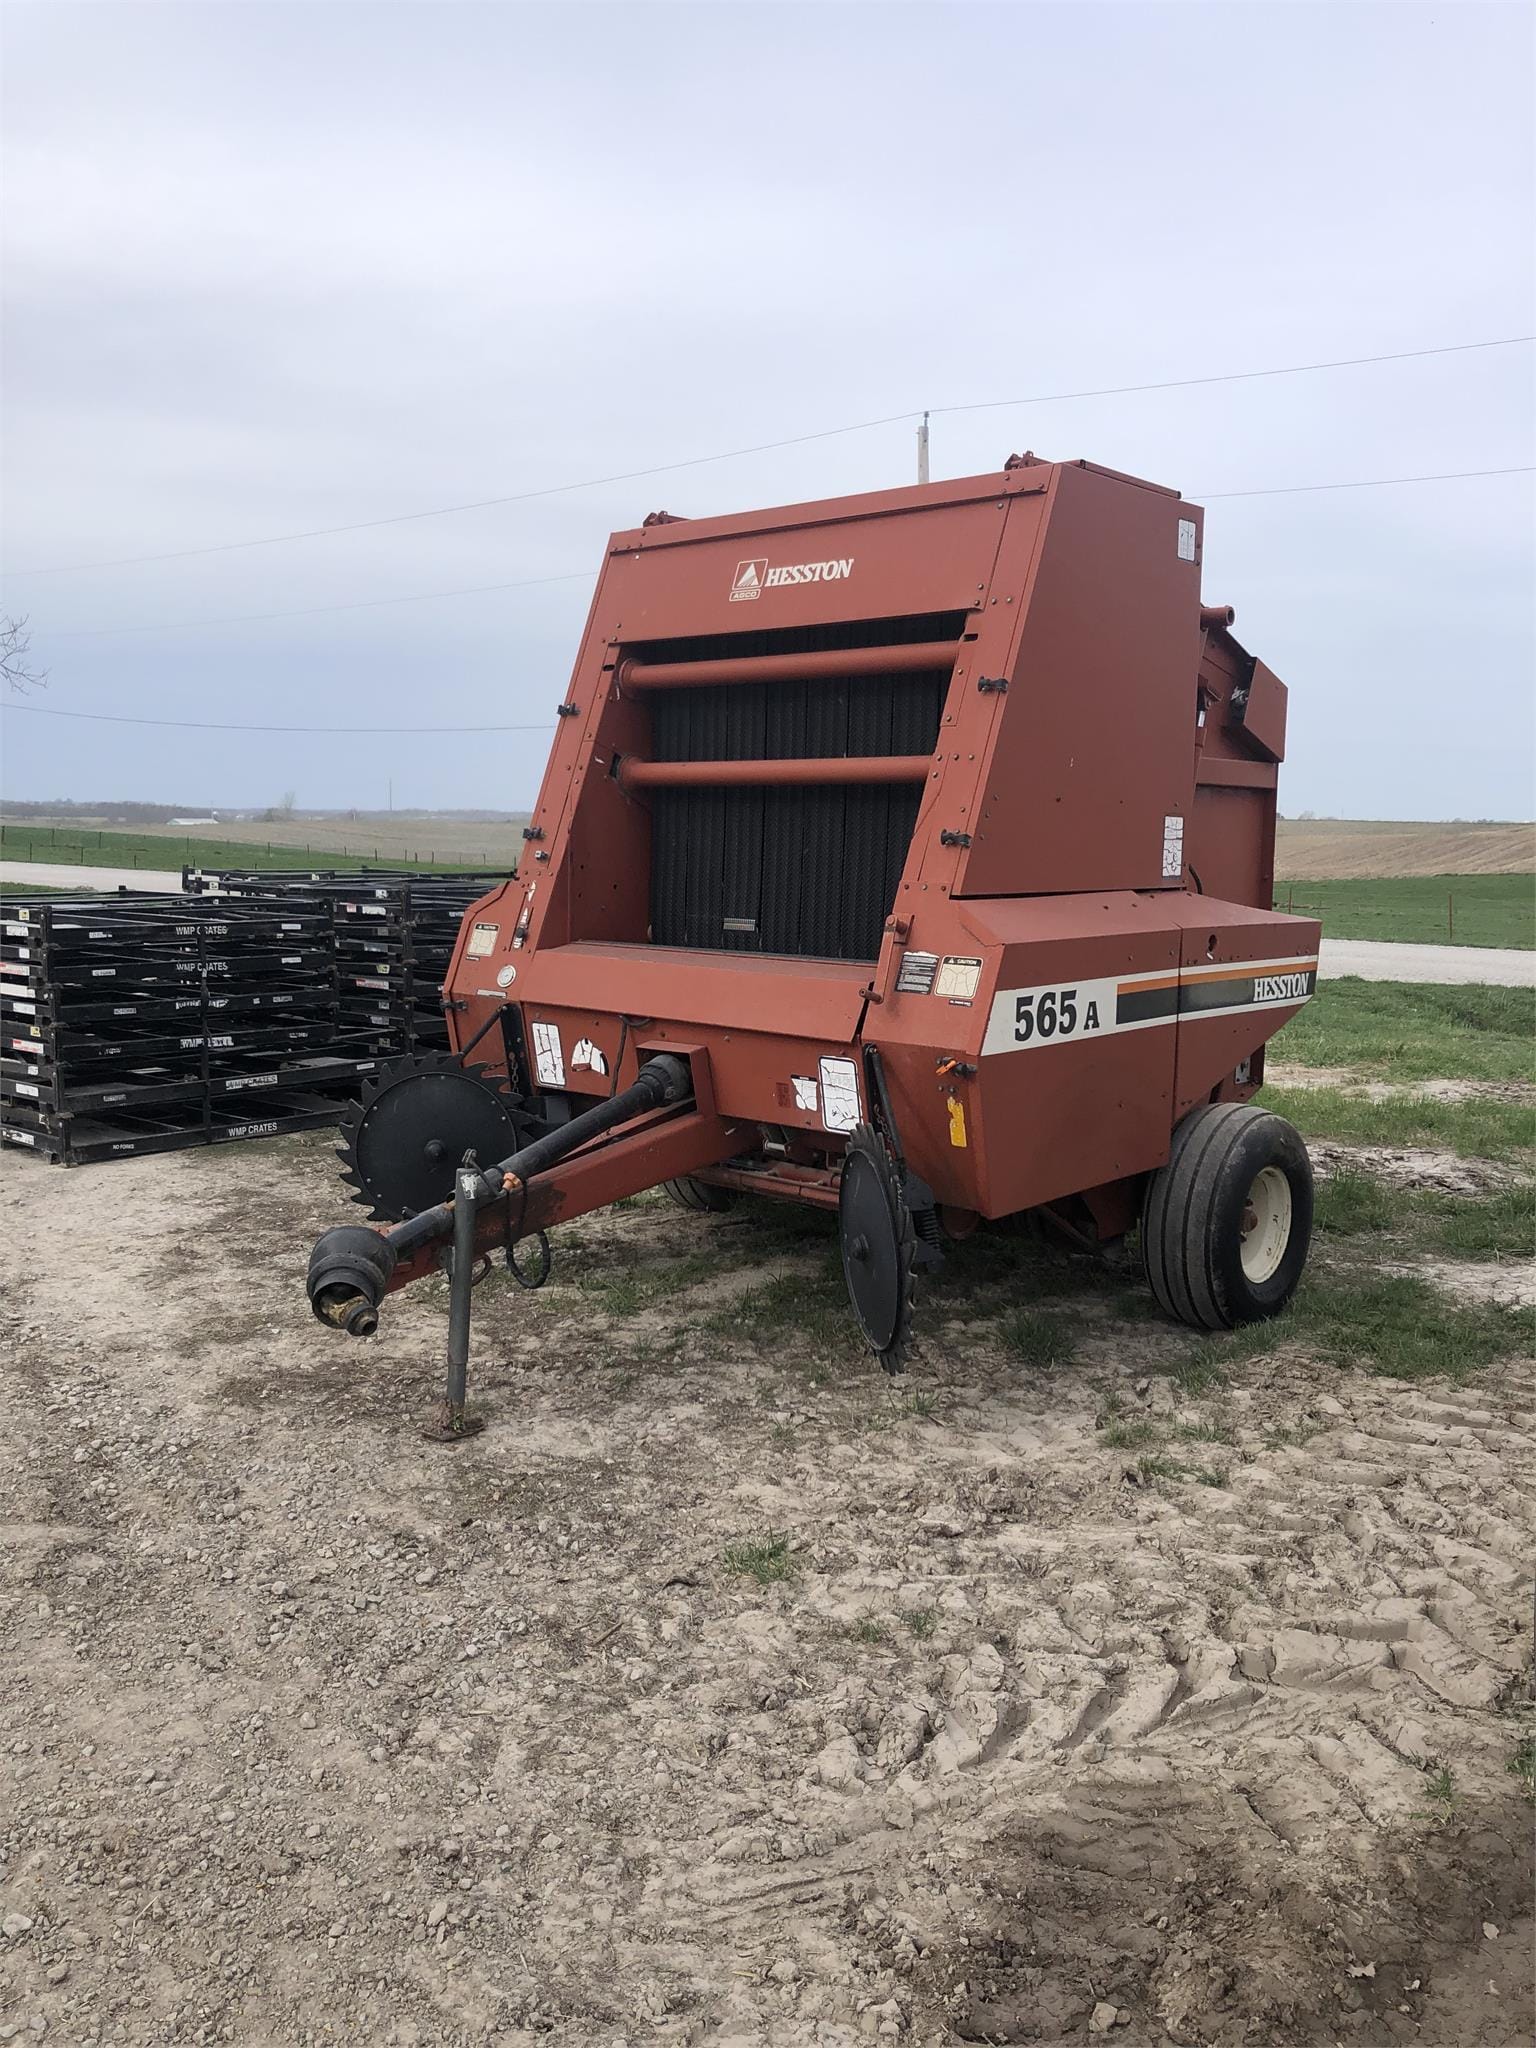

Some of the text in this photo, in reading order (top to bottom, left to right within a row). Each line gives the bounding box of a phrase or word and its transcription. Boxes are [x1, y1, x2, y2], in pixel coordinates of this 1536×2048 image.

[765, 558, 854, 587] HESSTON
[732, 591, 757, 599] AGCO
[176, 926, 196, 935] WMP
[176, 962, 196, 972] WMP
[1253, 972, 1310, 1003] HESSTON
[1014, 990, 1100, 1042] 565 A
[228, 1122, 278, 1137] WMP CRATES
